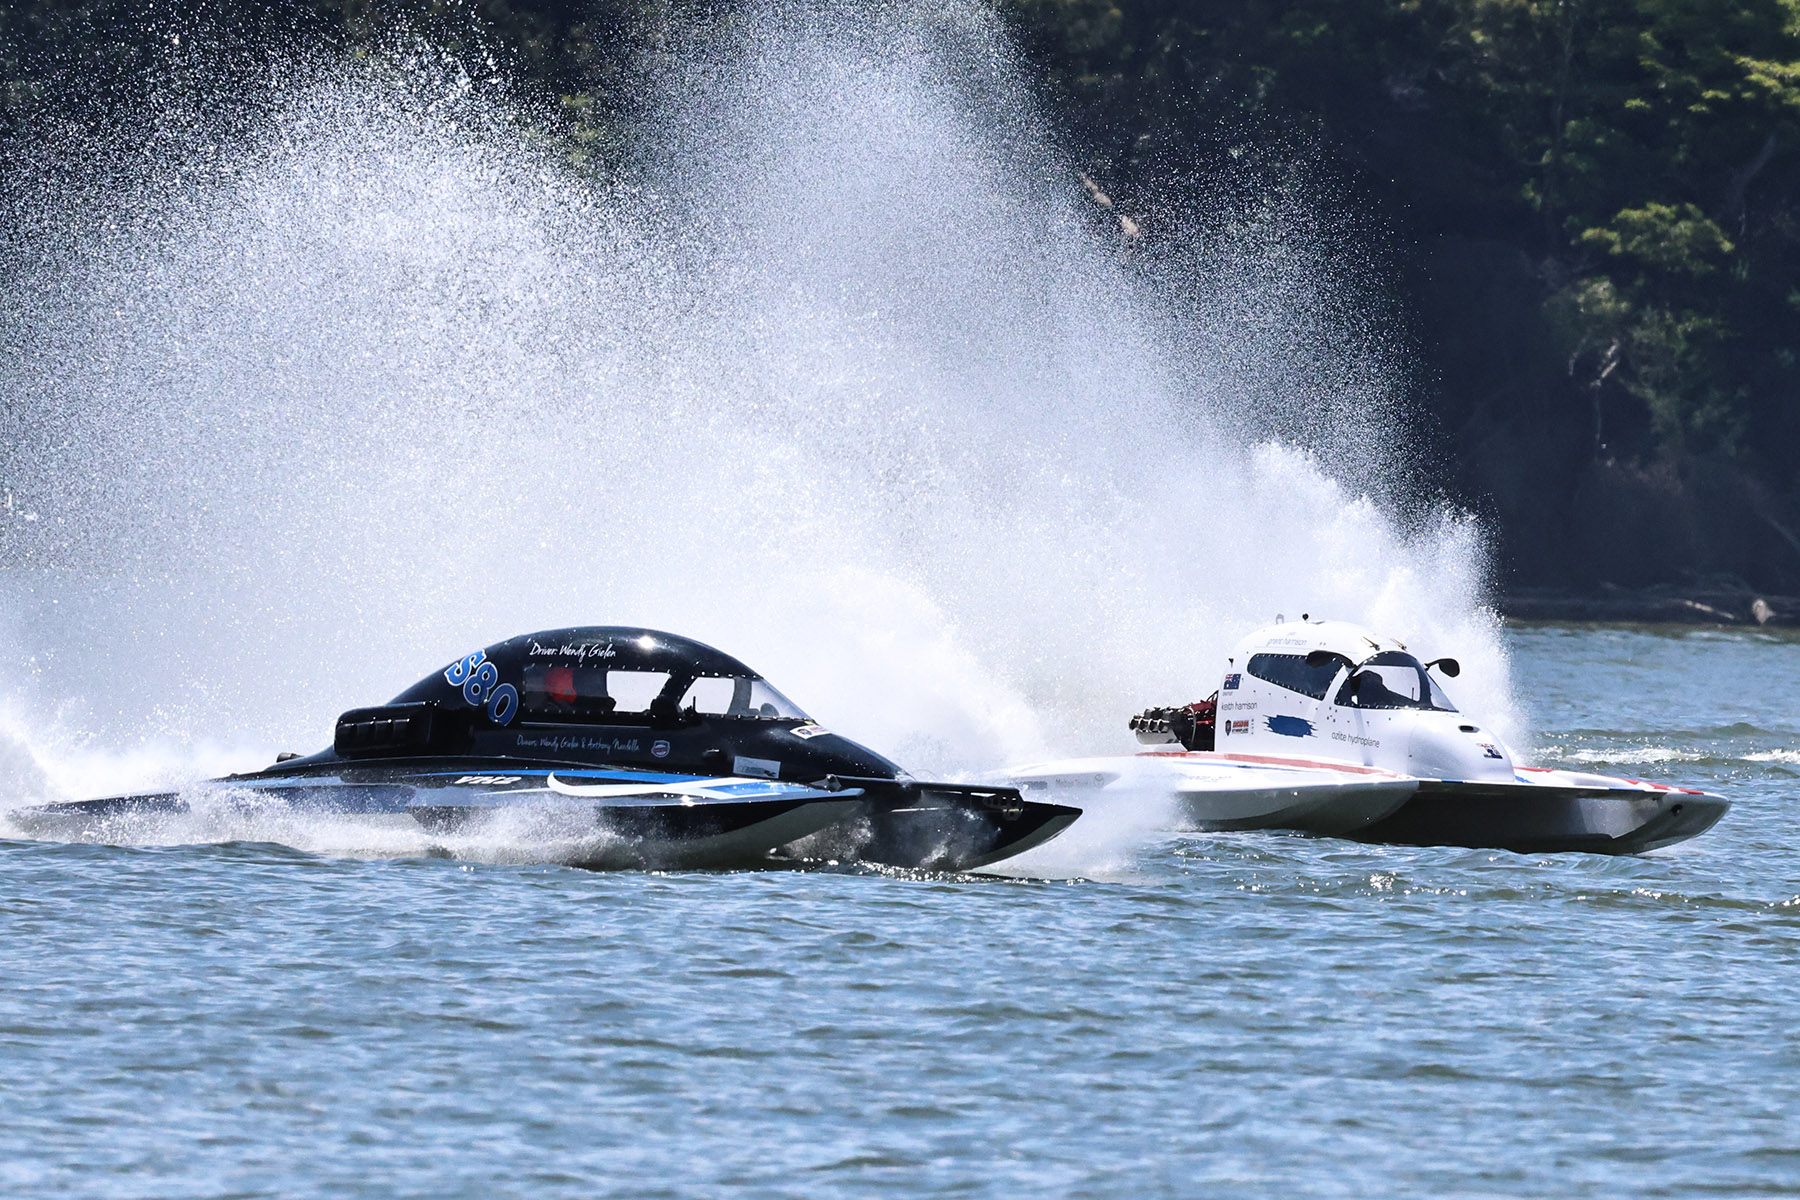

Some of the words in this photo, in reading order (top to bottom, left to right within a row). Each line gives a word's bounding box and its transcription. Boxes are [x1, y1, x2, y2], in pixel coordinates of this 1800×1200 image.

[558, 642, 587, 663] Wendy
[588, 642, 617, 660] Gielen
[443, 648, 519, 727] S80
